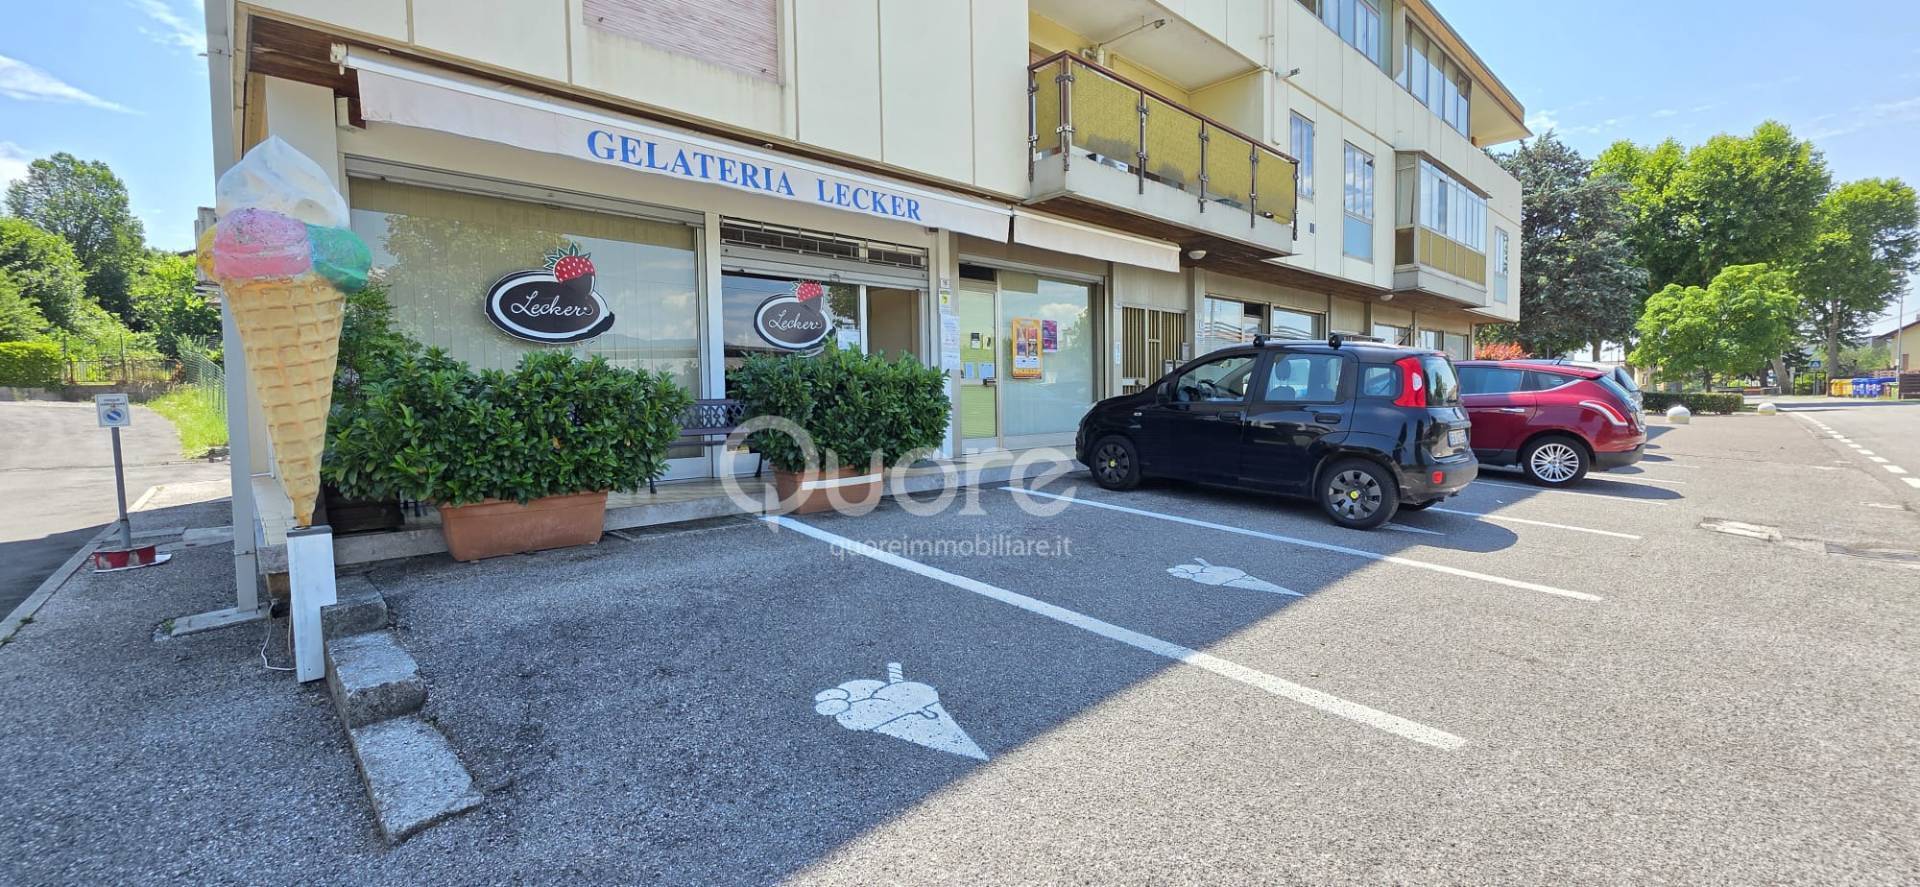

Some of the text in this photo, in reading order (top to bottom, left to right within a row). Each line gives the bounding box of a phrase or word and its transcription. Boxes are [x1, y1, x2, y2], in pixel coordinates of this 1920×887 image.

[587, 129, 922, 221] GELATERIA LECKER
[511, 290, 593, 317] Lecker
[768, 309, 822, 330] Lecker
